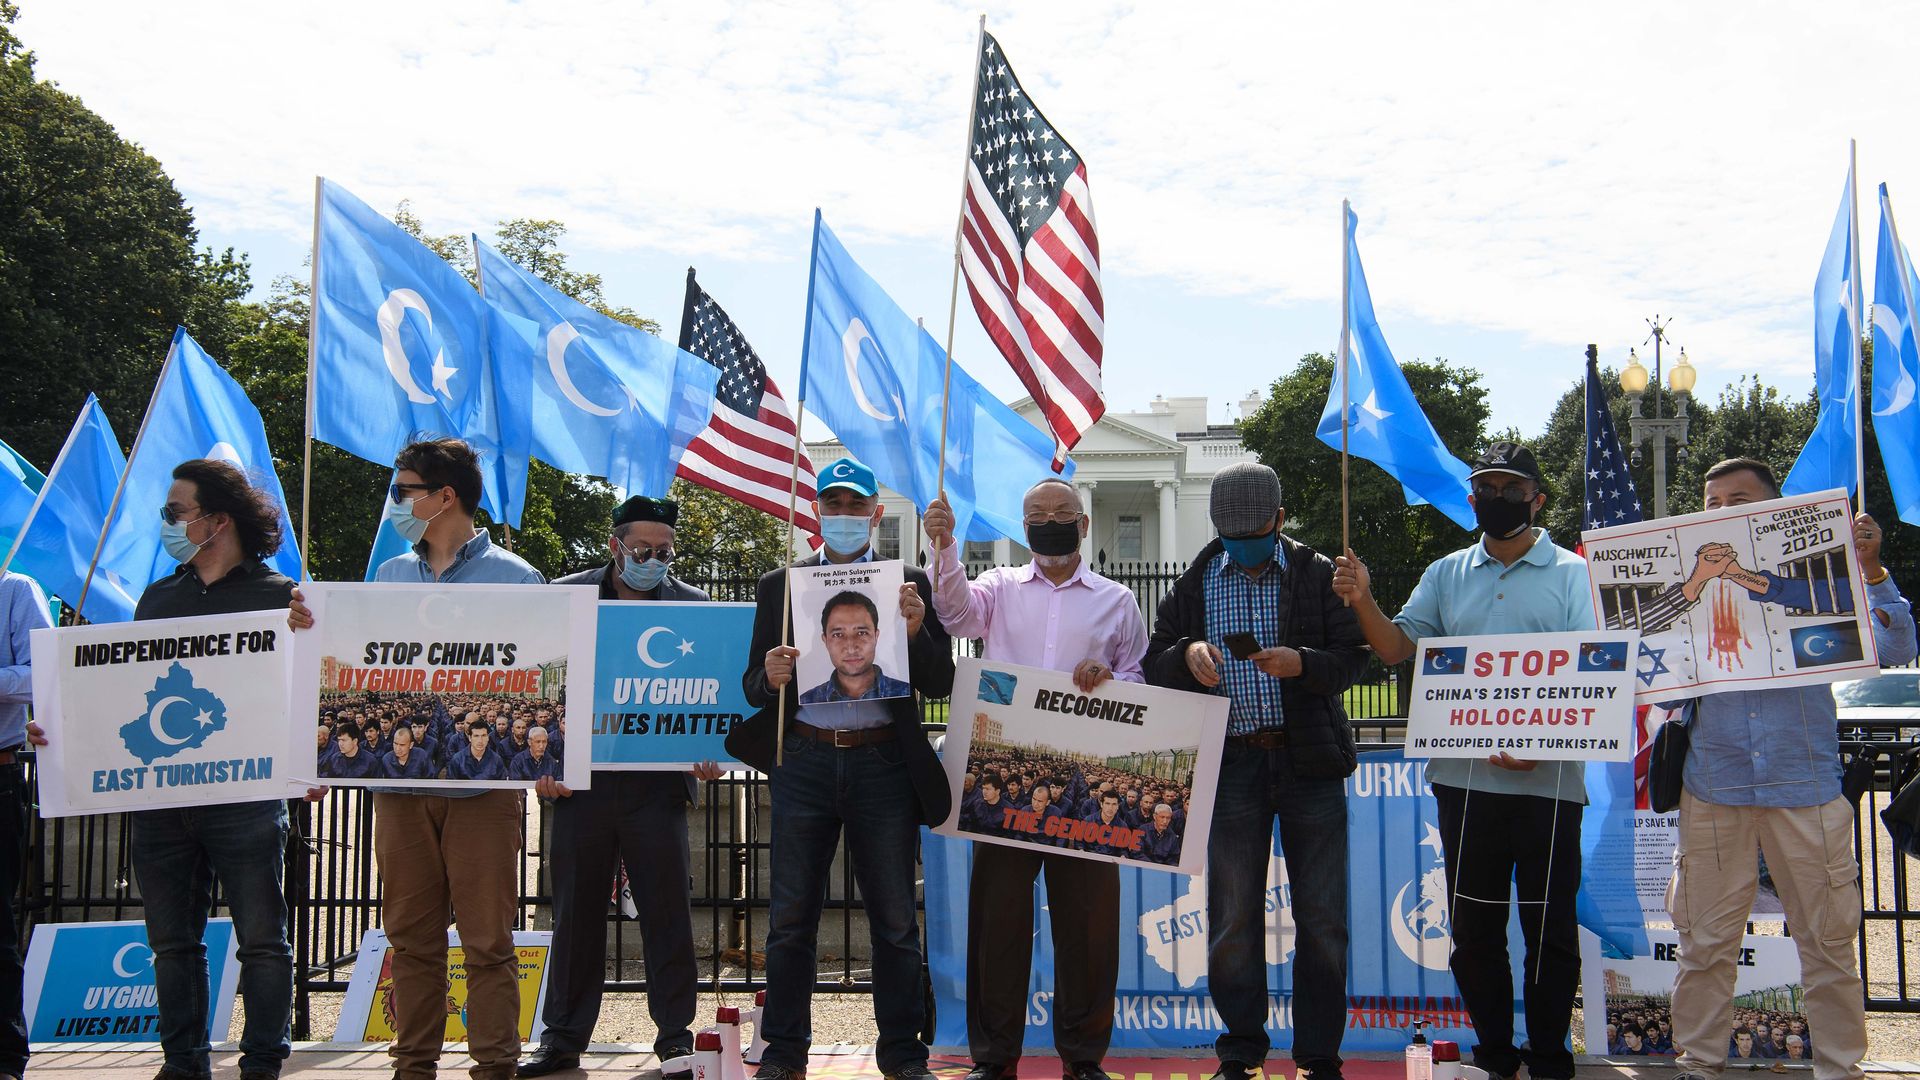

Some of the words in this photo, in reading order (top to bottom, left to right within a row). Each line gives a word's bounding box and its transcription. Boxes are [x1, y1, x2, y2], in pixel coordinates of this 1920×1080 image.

[1756, 509, 1843, 534] CONCENTRATION
[1772, 505, 1820, 522] CHINESE
[1782, 528, 1834, 555] 2020
[1784, 524, 1820, 538] CAMPS
[1593, 546, 1668, 562] AUSCHWITZ
[849, 568, 880, 576] Sulayman
[1612, 563, 1658, 579] 1942
[74, 633, 231, 667] INDEPENDENCE
[236, 630, 276, 654] FOR
[363, 642, 423, 665] STOP
[427, 642, 517, 666] CHINA'S
[1474, 650, 1570, 677] STOP
[338, 668, 426, 692] UYGHUR
[431, 669, 541, 694] GENOCIDE
[613, 678, 720, 705] UYGHUR
[1425, 688, 1488, 700] CHINA'S
[1493, 687, 1531, 700] 21ST
[1537, 686, 1617, 699] CENTURY
[1034, 689, 1148, 726] RECOGNIZE
[1450, 708, 1596, 726] HOLOCAUST
[592, 713, 650, 735] LIVES
[1414, 738, 1427, 748] IN
[1431, 738, 1493, 748] OCCUPIED
[1497, 738, 1533, 748] EAST
[1538, 738, 1618, 750] TURKISTAN
[92, 766, 148, 793] EAST
[153, 756, 273, 788] TURKISTAN
[1003, 808, 1040, 834] THE
[1044, 815, 1146, 850] GENOCIDE
[1624, 818, 1644, 828] HELP
[1646, 818, 1666, 828] SAVE
[1156, 910, 1203, 944] EAST
[83, 985, 159, 1010] UYGHU
[55, 1016, 111, 1037] LIVES
